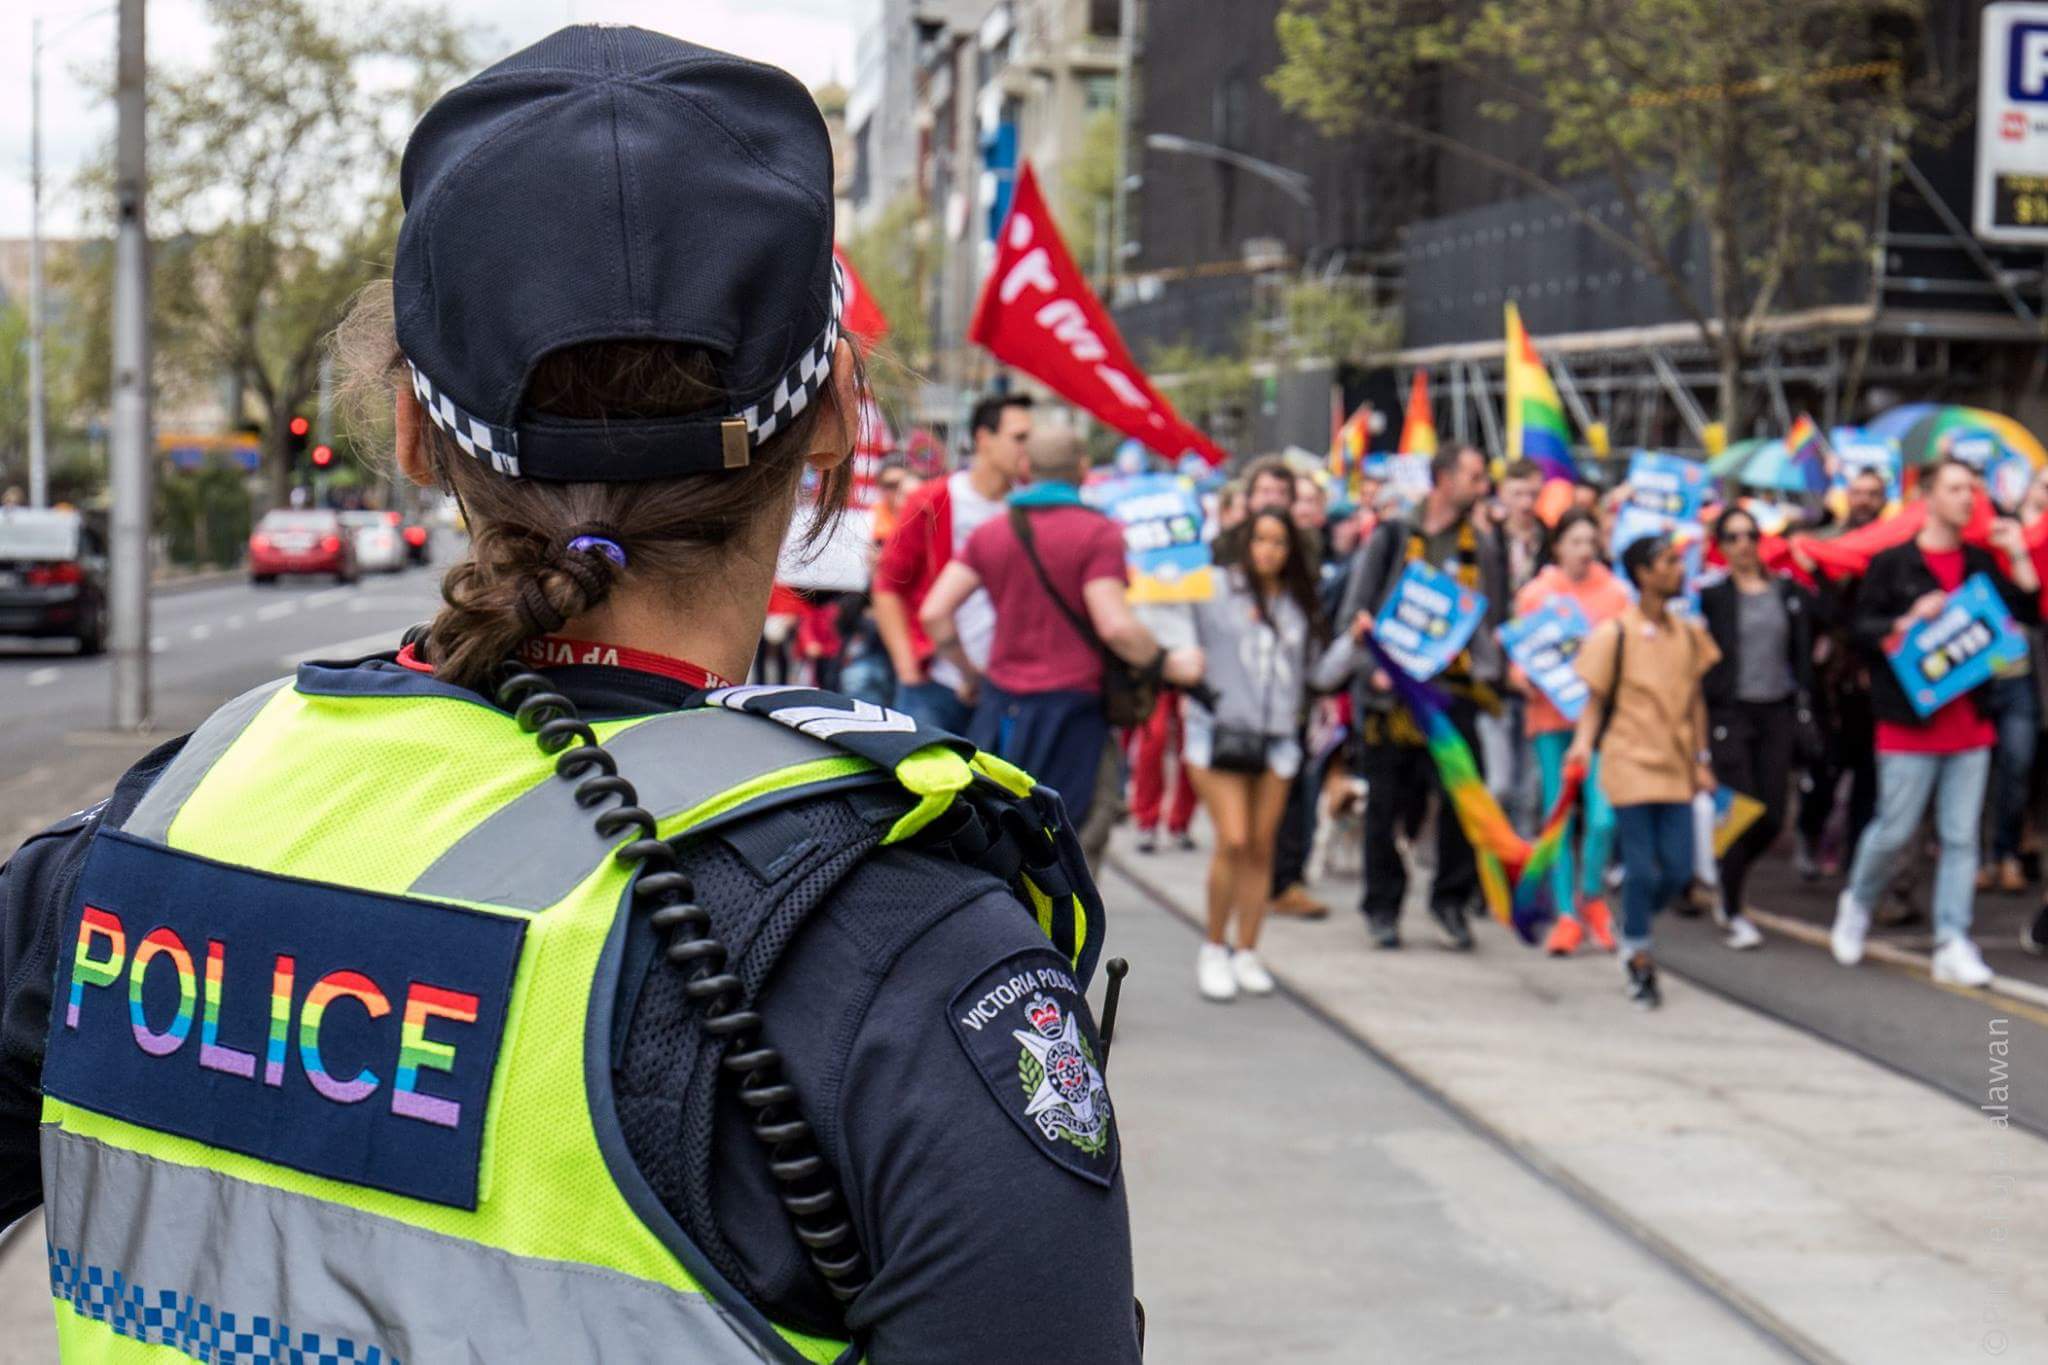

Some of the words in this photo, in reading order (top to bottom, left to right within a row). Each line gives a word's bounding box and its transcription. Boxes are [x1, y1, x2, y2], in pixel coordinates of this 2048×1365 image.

[582, 646, 619, 667] VP
[65, 904, 480, 1128] POLICE
[962, 971, 1038, 1031] VICTORIA
